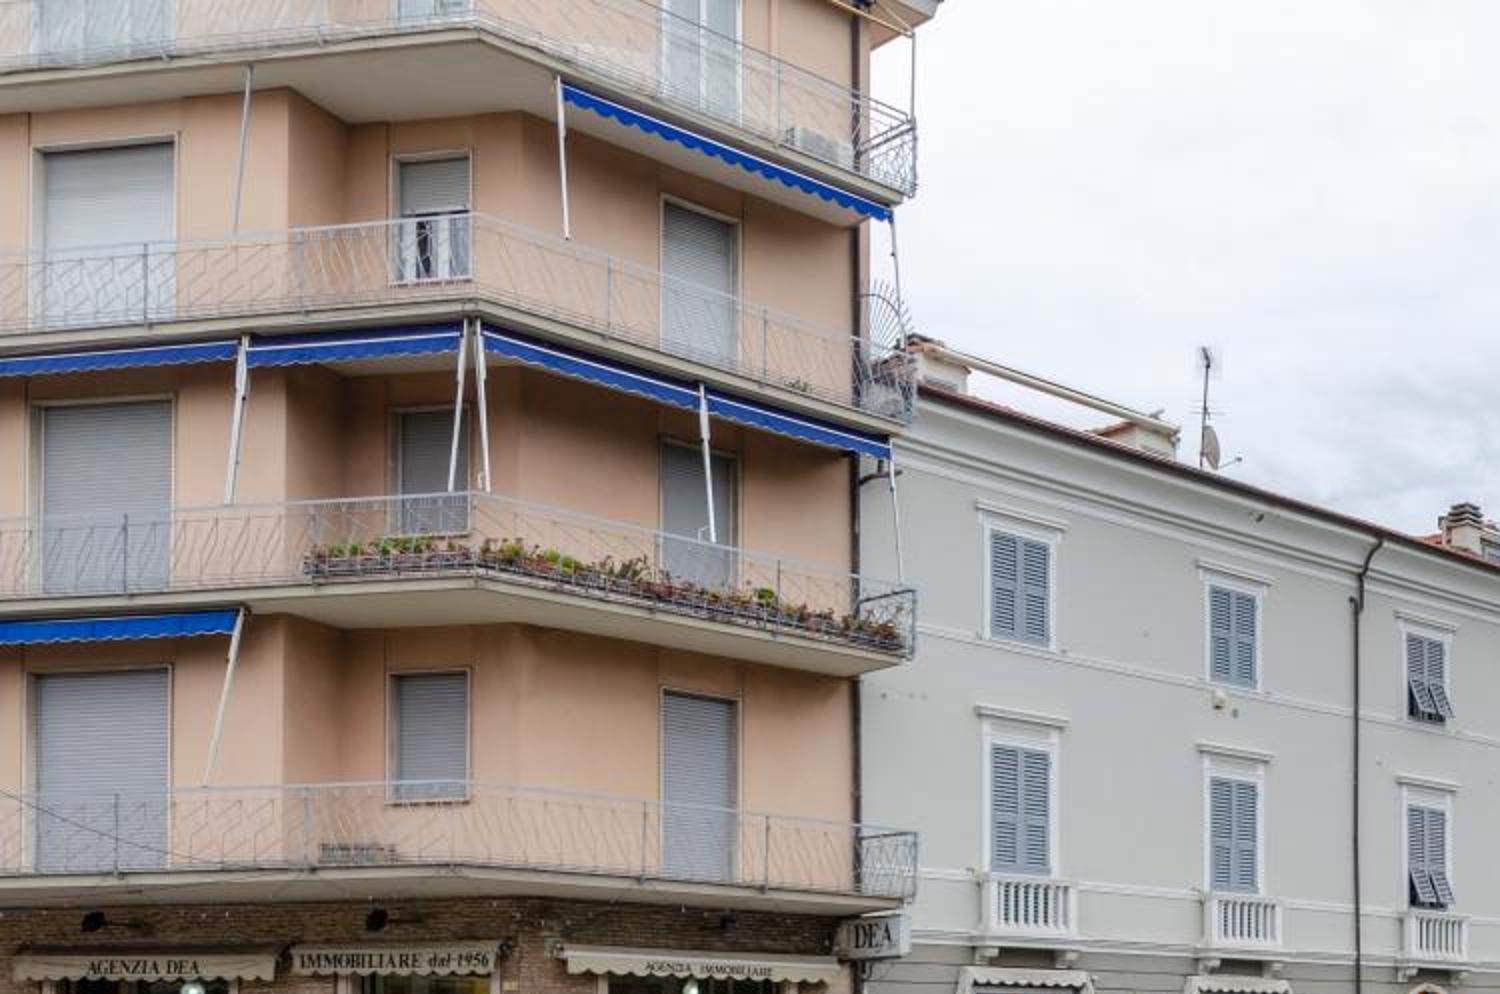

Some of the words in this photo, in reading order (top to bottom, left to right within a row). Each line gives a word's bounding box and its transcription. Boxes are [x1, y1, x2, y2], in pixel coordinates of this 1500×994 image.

[854, 921, 892, 948] DEA
[87, 959, 160, 975] AGENZIA
[166, 959, 200, 974] DEA
[300, 953, 420, 969] IMMOBILIARE
[428, 952, 450, 968] dal
[645, 961, 692, 974] AGENZIA
[699, 963, 773, 977] IMMOBILIARE
